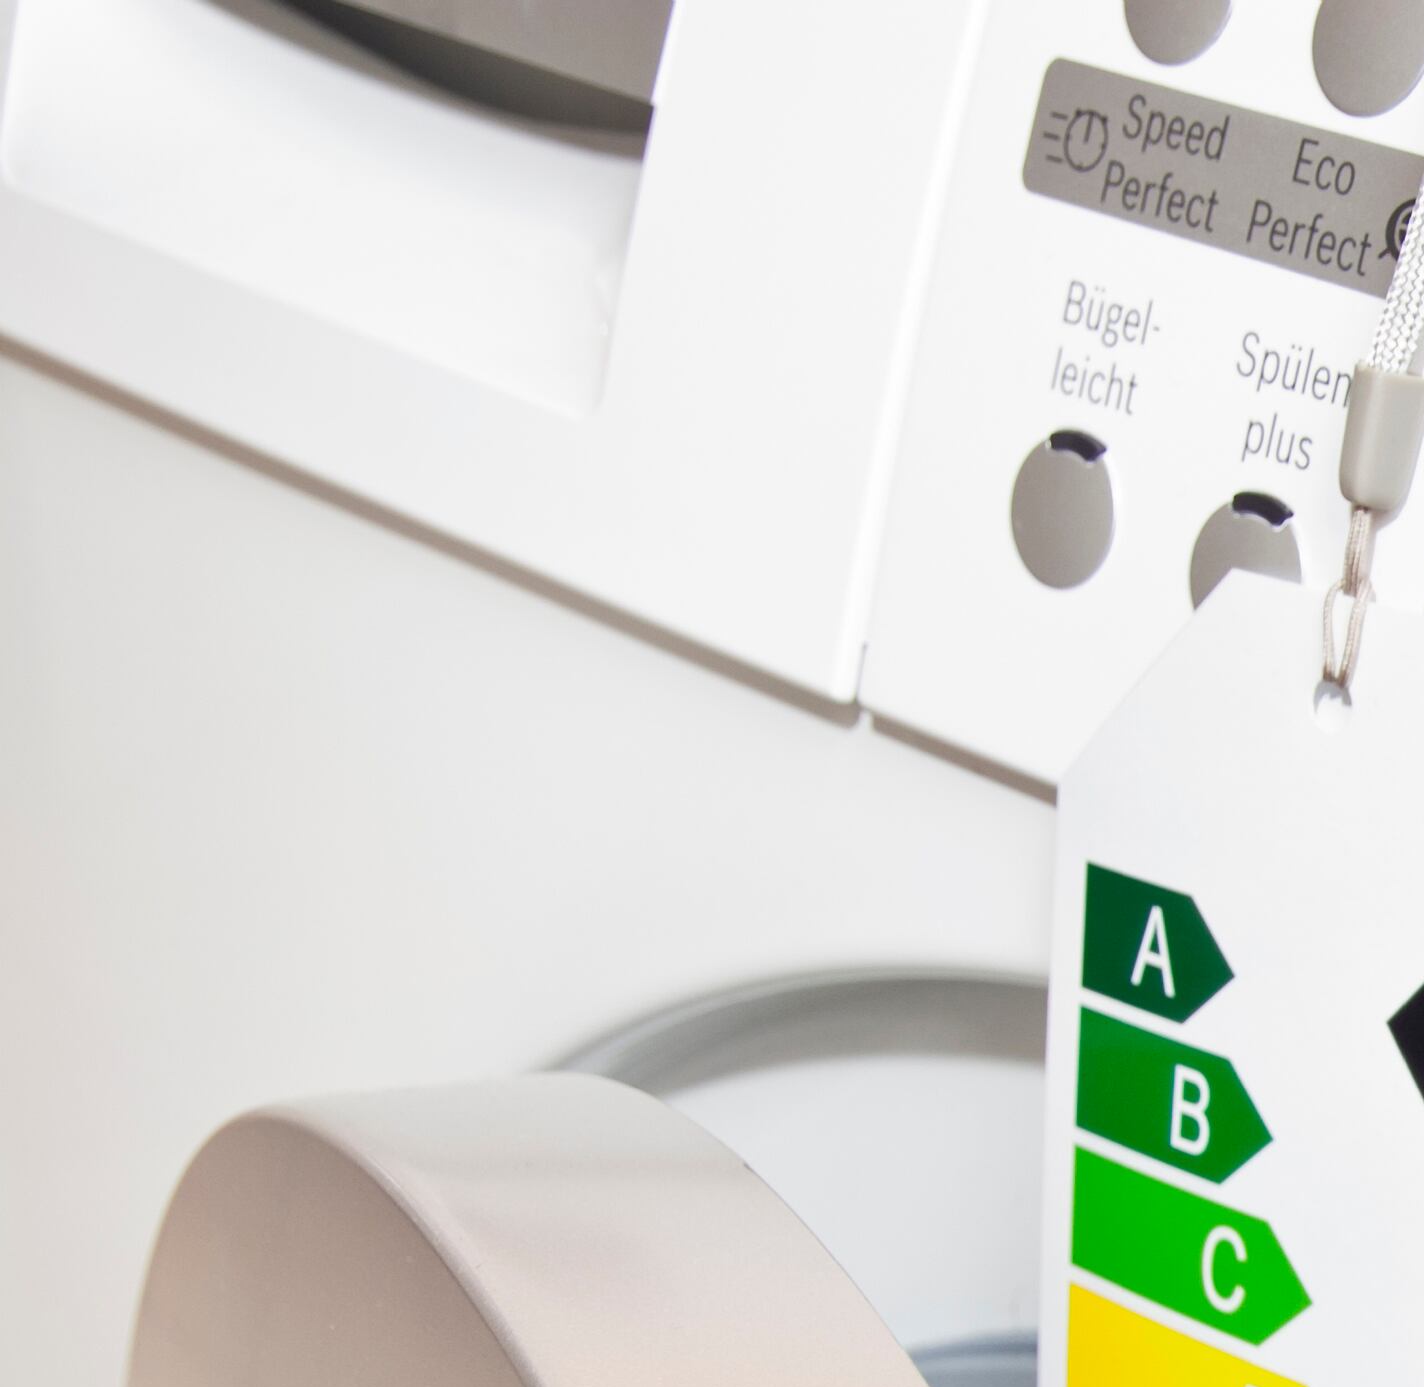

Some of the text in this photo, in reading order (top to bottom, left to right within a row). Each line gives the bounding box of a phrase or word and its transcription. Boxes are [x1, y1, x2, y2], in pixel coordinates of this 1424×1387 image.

[1121, 94, 1231, 161] Speed
[1100, 159, 1219, 233] Perfect
[1291, 138, 1357, 197] Eco
[1246, 199, 1372, 277] Perfect
[1061, 279, 1161, 348] Bügel-
[1050, 347, 1139, 416] leicht
[1235, 331, 1353, 409] Spülen
[1240, 412, 1313, 472] plus
[1130, 905, 1177, 998] A
[1168, 1063, 1211, 1156] B
[1200, 1225, 1248, 1314] C
